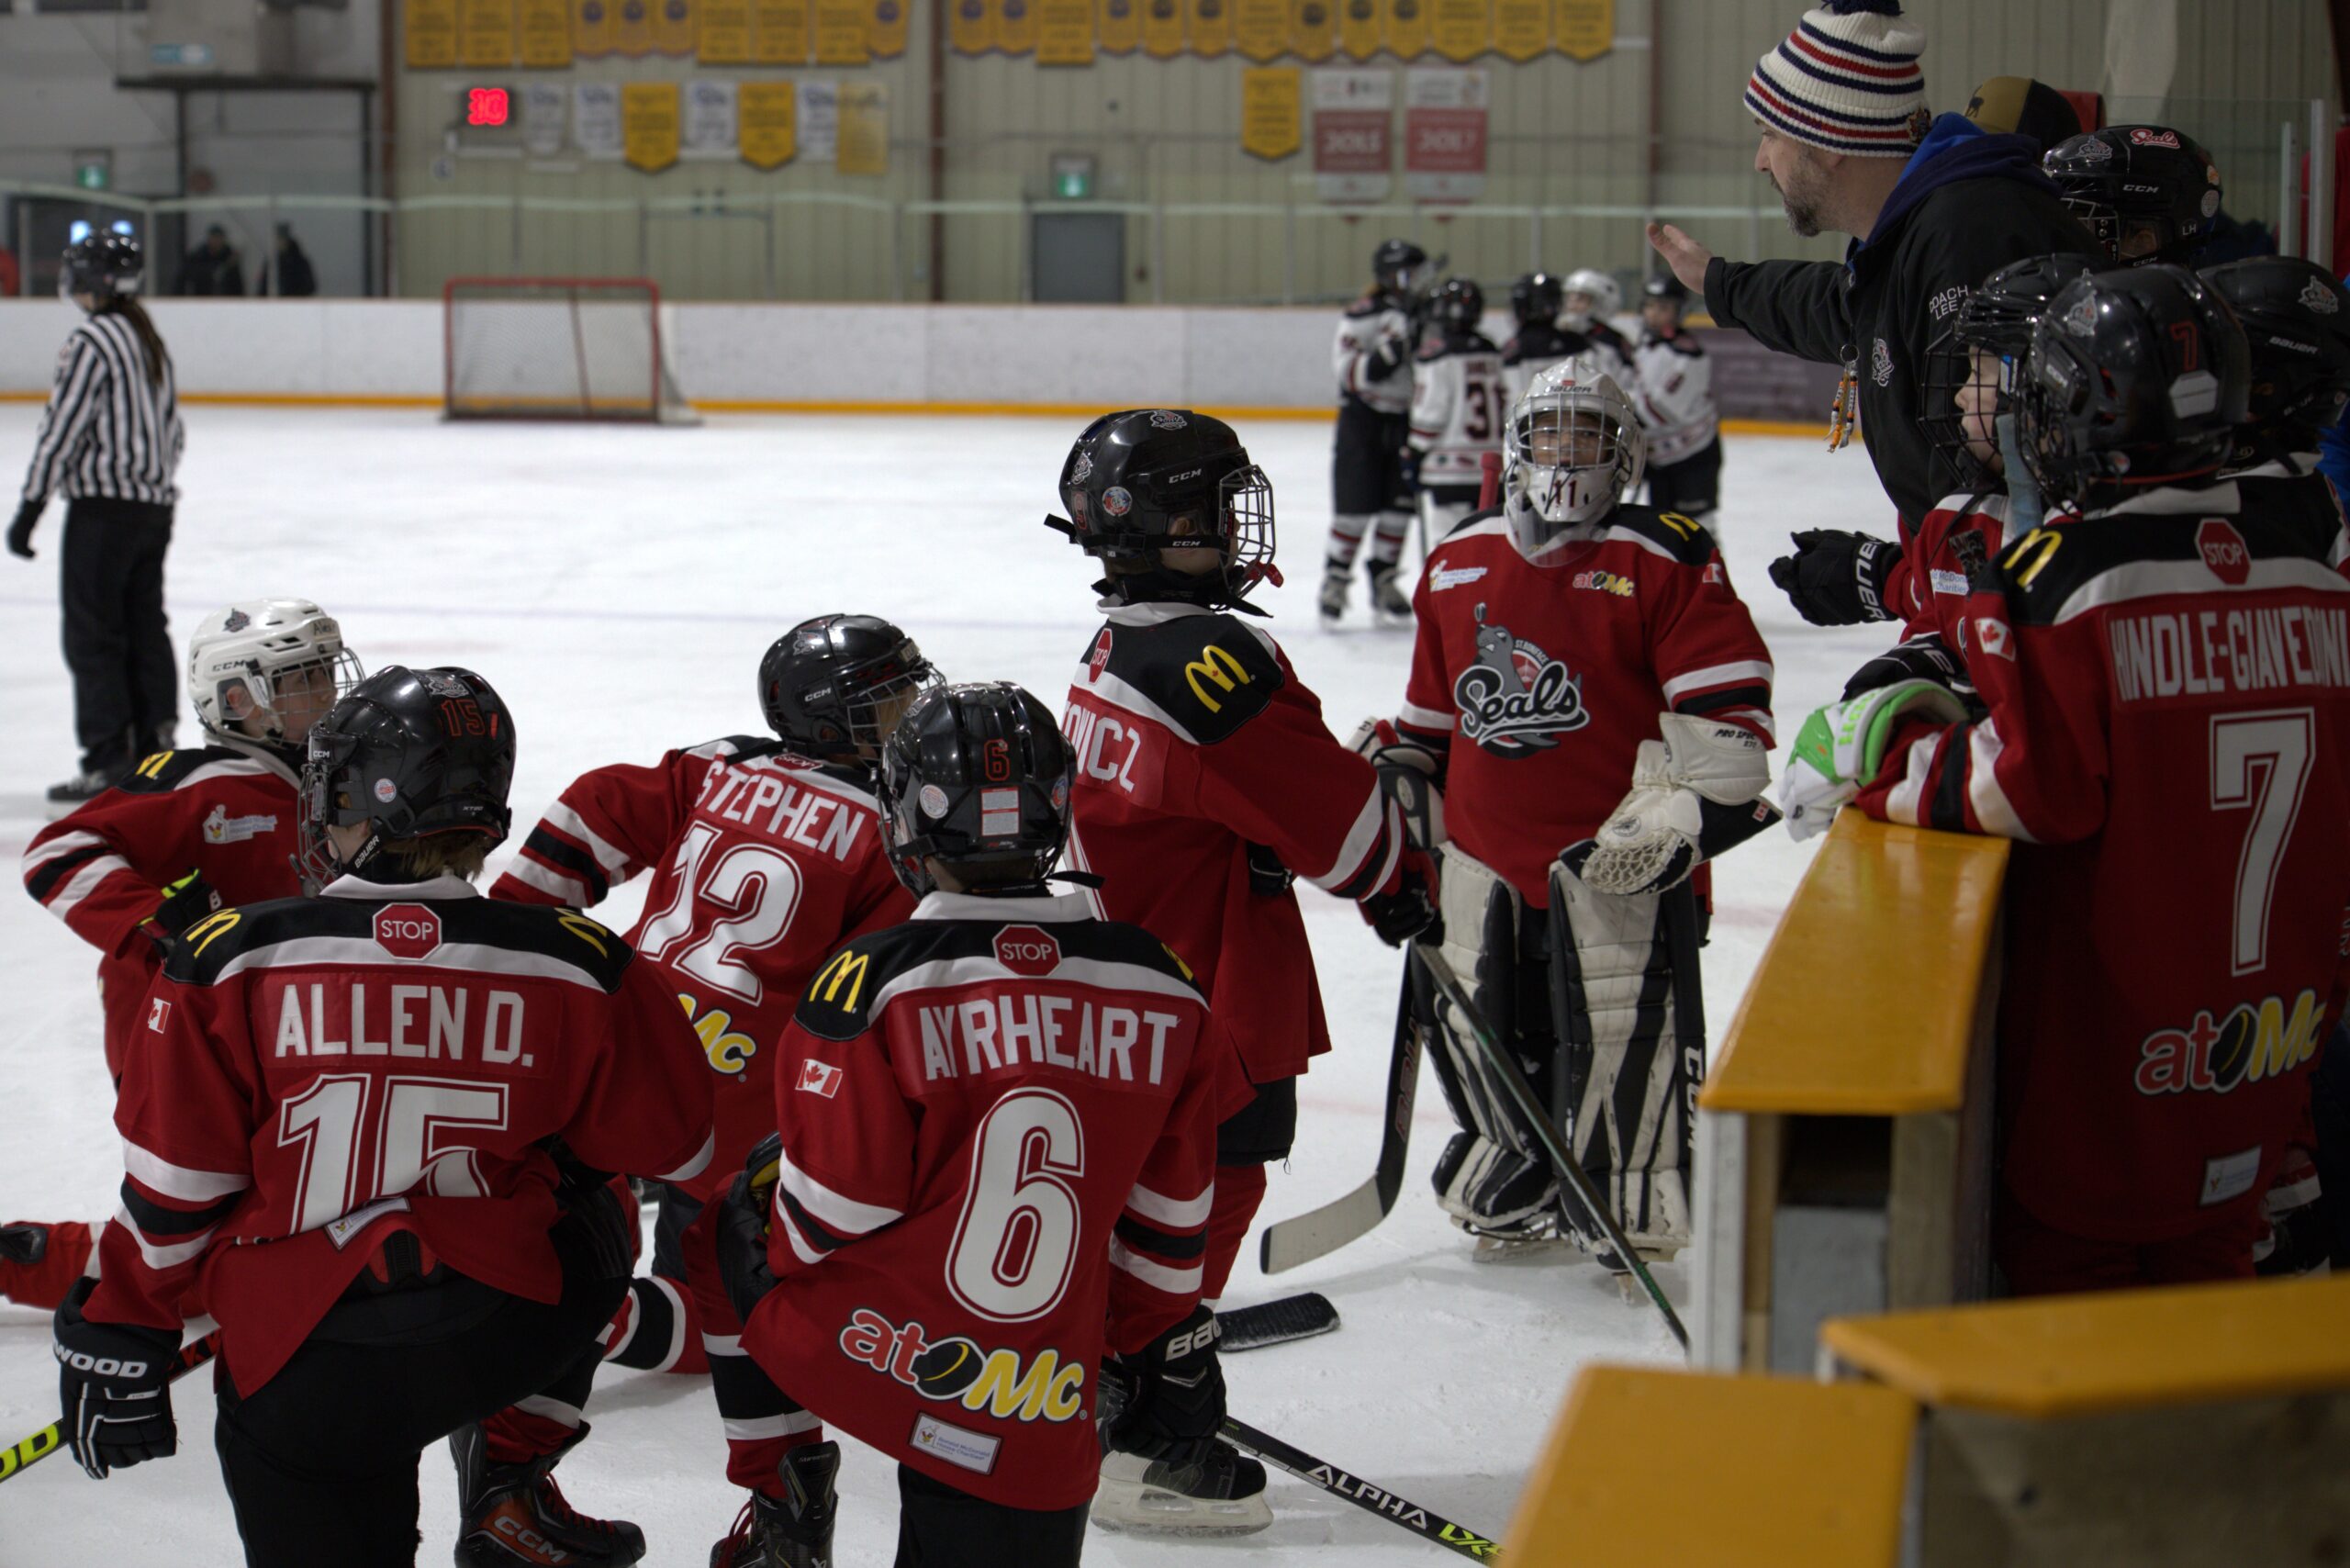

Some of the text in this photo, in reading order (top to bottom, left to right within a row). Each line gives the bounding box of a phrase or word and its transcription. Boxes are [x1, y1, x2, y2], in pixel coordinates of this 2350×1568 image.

[2130, 129, 2181, 150] Seals
[2122, 184, 2160, 194] CCM
[2182, 224, 2197, 236] LH
[1935, 299, 1958, 320] LEE
[2169, 319, 2199, 372] 7
[2268, 336, 2321, 355] BAUER
[1169, 468, 1202, 484] CCM
[1172, 540, 1202, 548] CCM
[2204, 542, 2244, 566] STOP
[212, 658, 246, 672] CCM
[804, 687, 832, 702] CCM
[1454, 660, 1591, 746] Seals
[441, 698, 485, 738] 15
[1715, 728, 1736, 738] PRO
[313, 749, 330, 758] CCM
[984, 738, 1010, 781] 6
[694, 757, 866, 863] STEPHEN
[354, 835, 380, 868] BAUER
[2208, 705, 2317, 979] 7
[636, 819, 804, 1008] 12
[380, 919, 434, 941] STOP
[1001, 942, 1054, 962] STOP
[274, 983, 535, 1068] ALLEN D.
[919, 993, 1183, 1087] AYRHEART
[277, 1072, 510, 1238] 15
[944, 1085, 1085, 1324] 6
[1305, 1463, 1431, 1531] ALPHA
[494, 1515, 569, 1563] CCM
